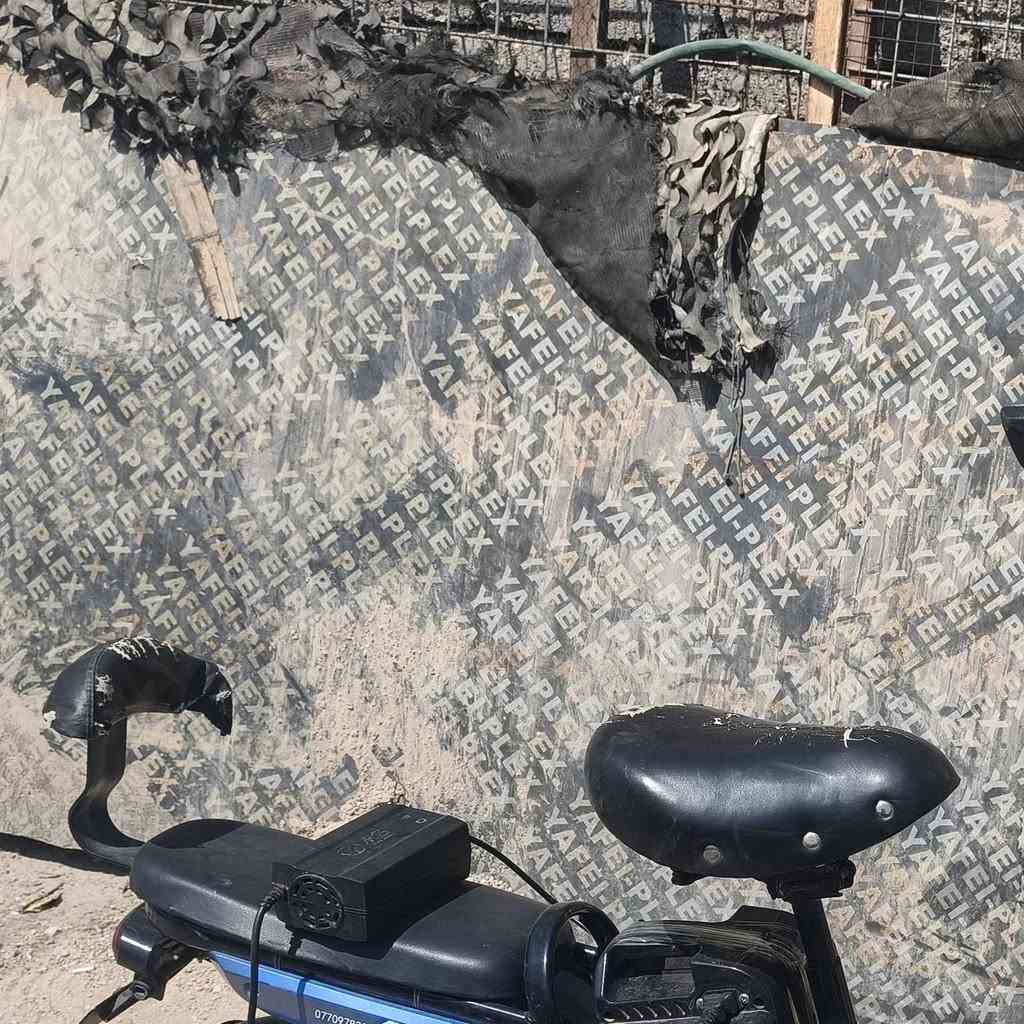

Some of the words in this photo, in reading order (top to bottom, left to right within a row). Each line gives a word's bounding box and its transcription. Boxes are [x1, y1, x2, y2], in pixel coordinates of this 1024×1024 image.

[332, 155, 443, 311] AFEI-PLEX
[359, 138, 468, 291] AFEI-PLEX
[445, 151, 520, 252] -PLEX
[753, 188, 832, 295] I-PLEX
[767, 148, 859, 273] EI-PLEX
[798, 131, 887, 251] EI-PLEX
[272, 181, 393, 353] YAFEI-PLEX
[237, 298, 320, 411] EI-PLEX
[856, 280, 988, 466] YAFEI-PLEX
[24, 414, 129, 562] AFEI-PLEX
[777, 347, 905, 529] YAFEI-PLEX
[0, 472, 84, 601] FEI-PLEX
[1, 434, 107, 582] AFEI-PLEX
[454, 677, 539, 793] EI-PLEX
[566, 790, 659, 921] YAFEI-PL
